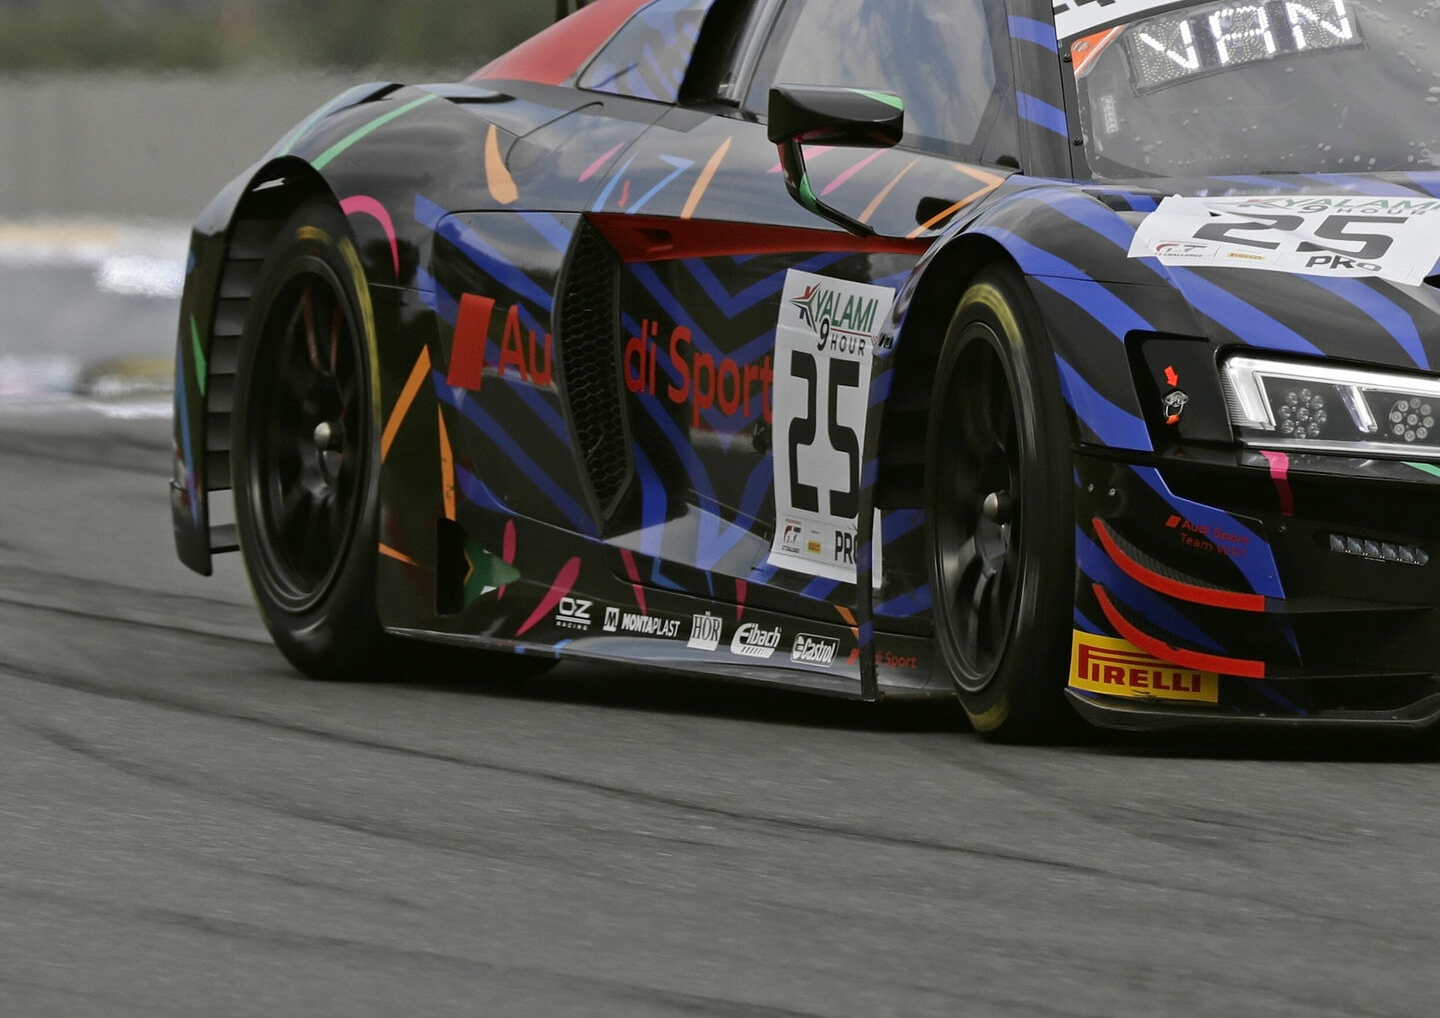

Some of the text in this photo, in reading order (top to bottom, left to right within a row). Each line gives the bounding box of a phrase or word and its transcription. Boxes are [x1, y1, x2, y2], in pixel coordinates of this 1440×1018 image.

[1297, 204, 1426, 216] 9 HOUR
[1192, 210, 1410, 260] 25
[790, 281, 879, 334] KYALAMI
[816, 317, 867, 357] 9 HOUR
[498, 304, 774, 429] Audi Sport
[788, 350, 861, 519] 25
[1180, 533, 1213, 552] Team
[558, 596, 593, 619] OZ
[556, 621, 588, 631] RACING
[620, 612, 681, 638] MONTAPLAST
[730, 622, 782, 656] Eibach
[799, 637, 837, 664] Castrol
[1077, 642, 1202, 694] PIRELLI
